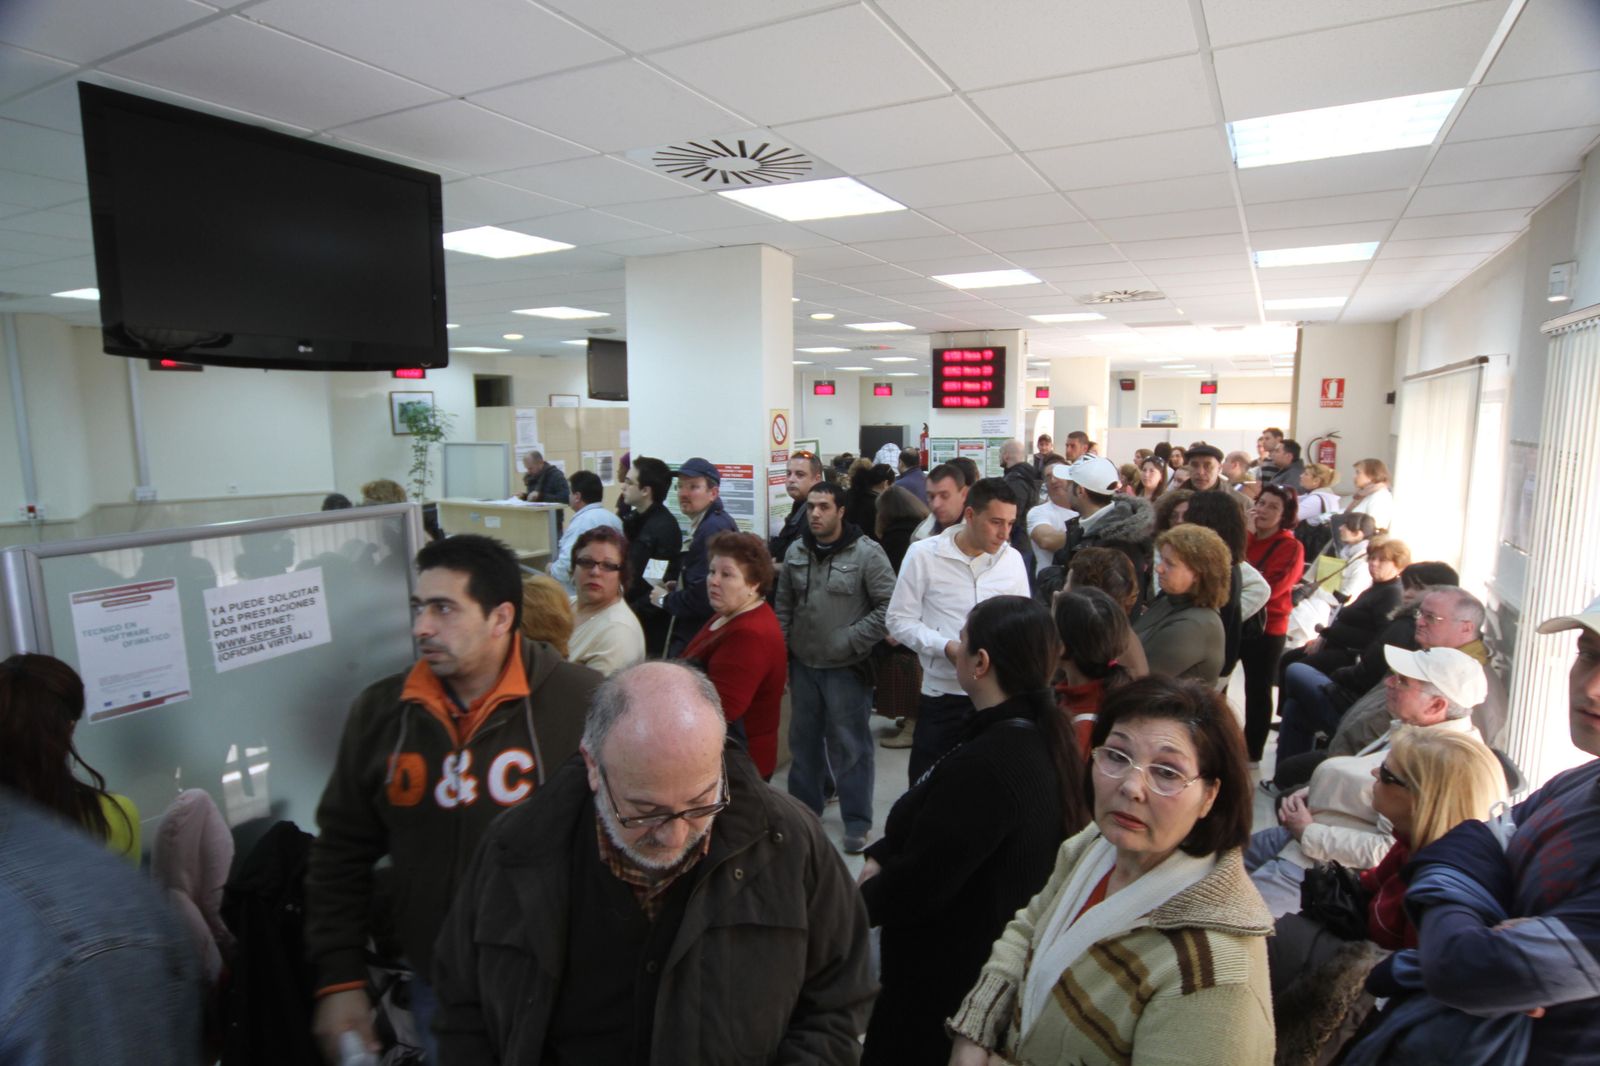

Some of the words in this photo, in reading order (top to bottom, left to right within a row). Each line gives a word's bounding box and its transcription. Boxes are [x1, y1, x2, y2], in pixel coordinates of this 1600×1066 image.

[211, 605, 226, 616] YA
[228, 597, 265, 612] PUEDE
[268, 585, 320, 603] SOLICITAR
[212, 615, 234, 628] LAS
[237, 597, 316, 621] PRESTACIONES
[214, 626, 238, 639] POR
[240, 614, 295, 633] INTERNET:
[216, 625, 293, 651] WWW.SEPE.ES
[218, 643, 265, 662] (OFICINA
[267, 630, 313, 649] VIRTUAL)
